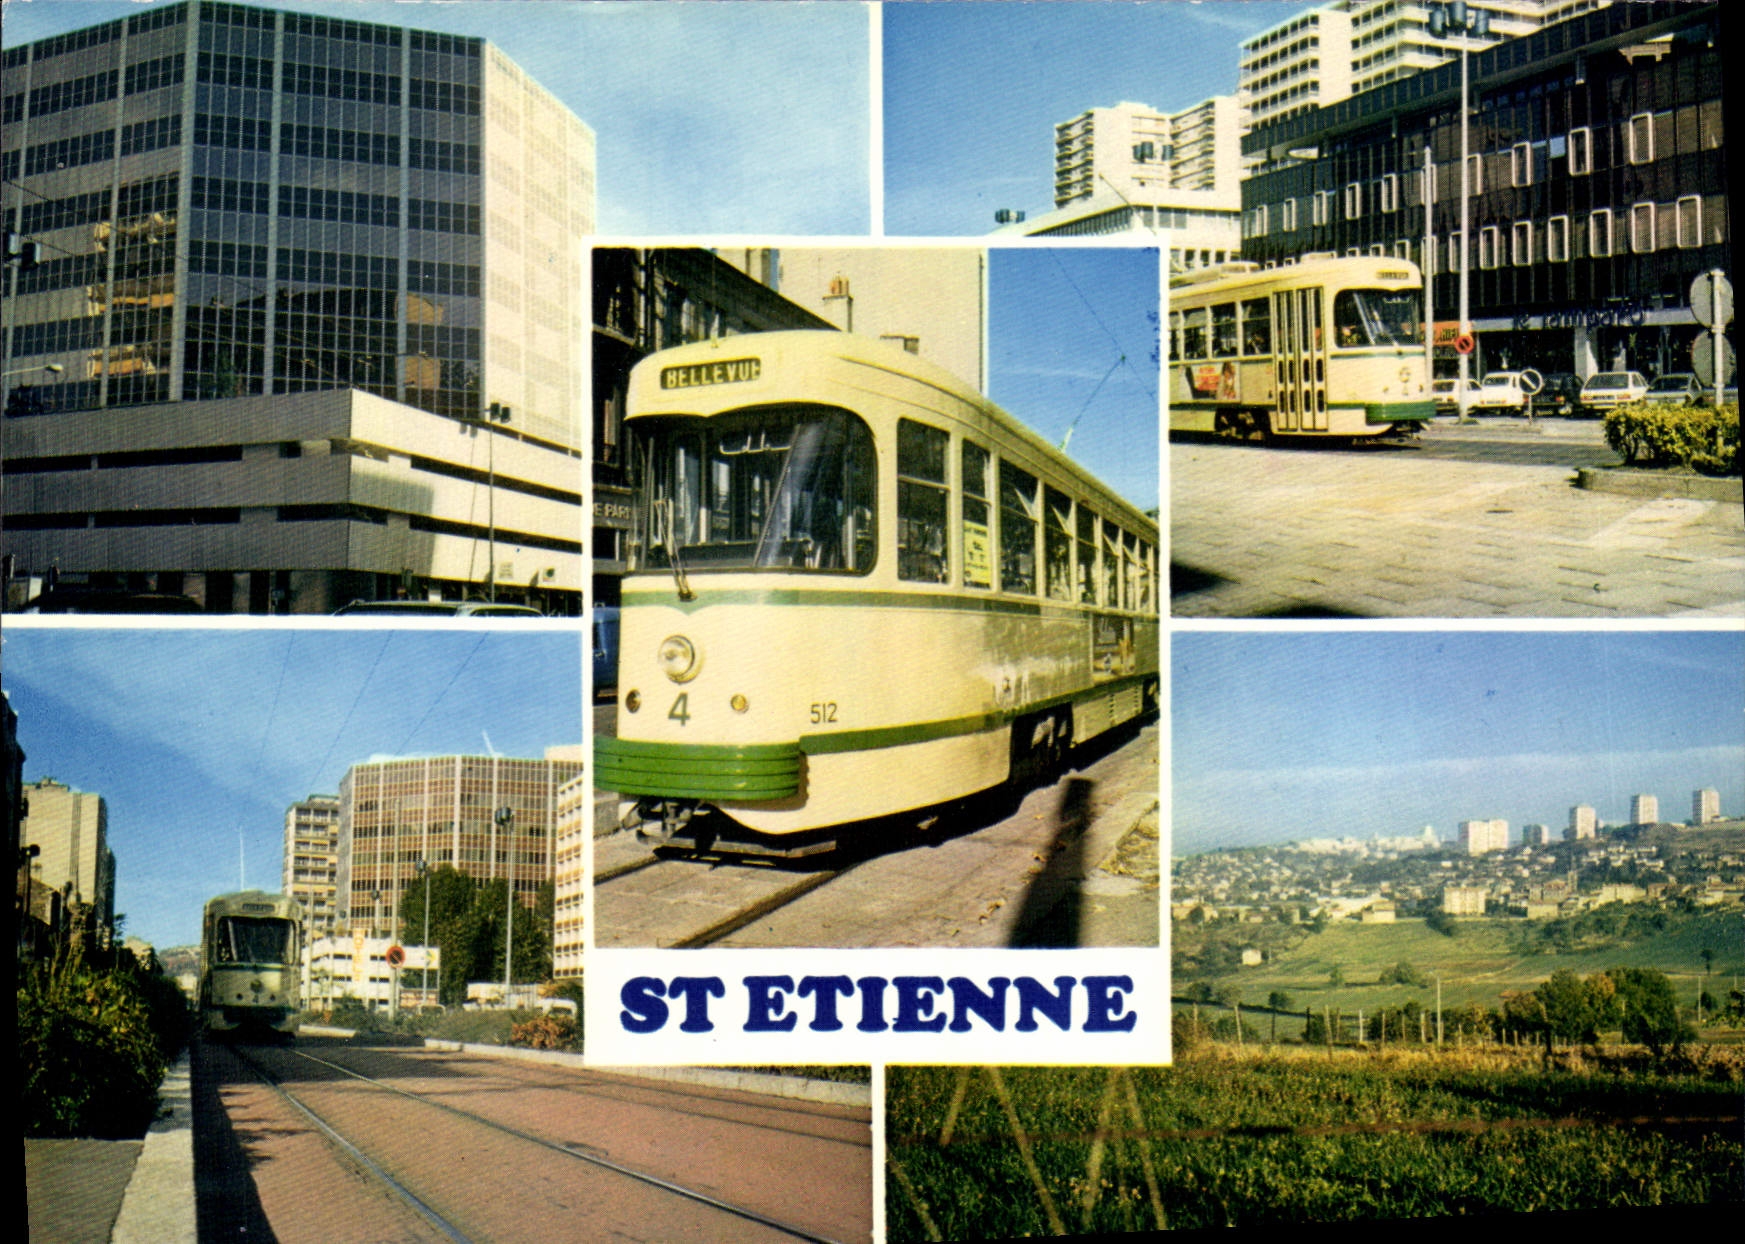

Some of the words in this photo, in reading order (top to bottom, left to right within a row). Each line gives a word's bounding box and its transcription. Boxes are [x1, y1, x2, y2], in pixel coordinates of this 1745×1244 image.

[666, 360, 760, 389] BELLEVUE
[668, 692, 691, 727] 4
[810, 702, 838, 724] 512
